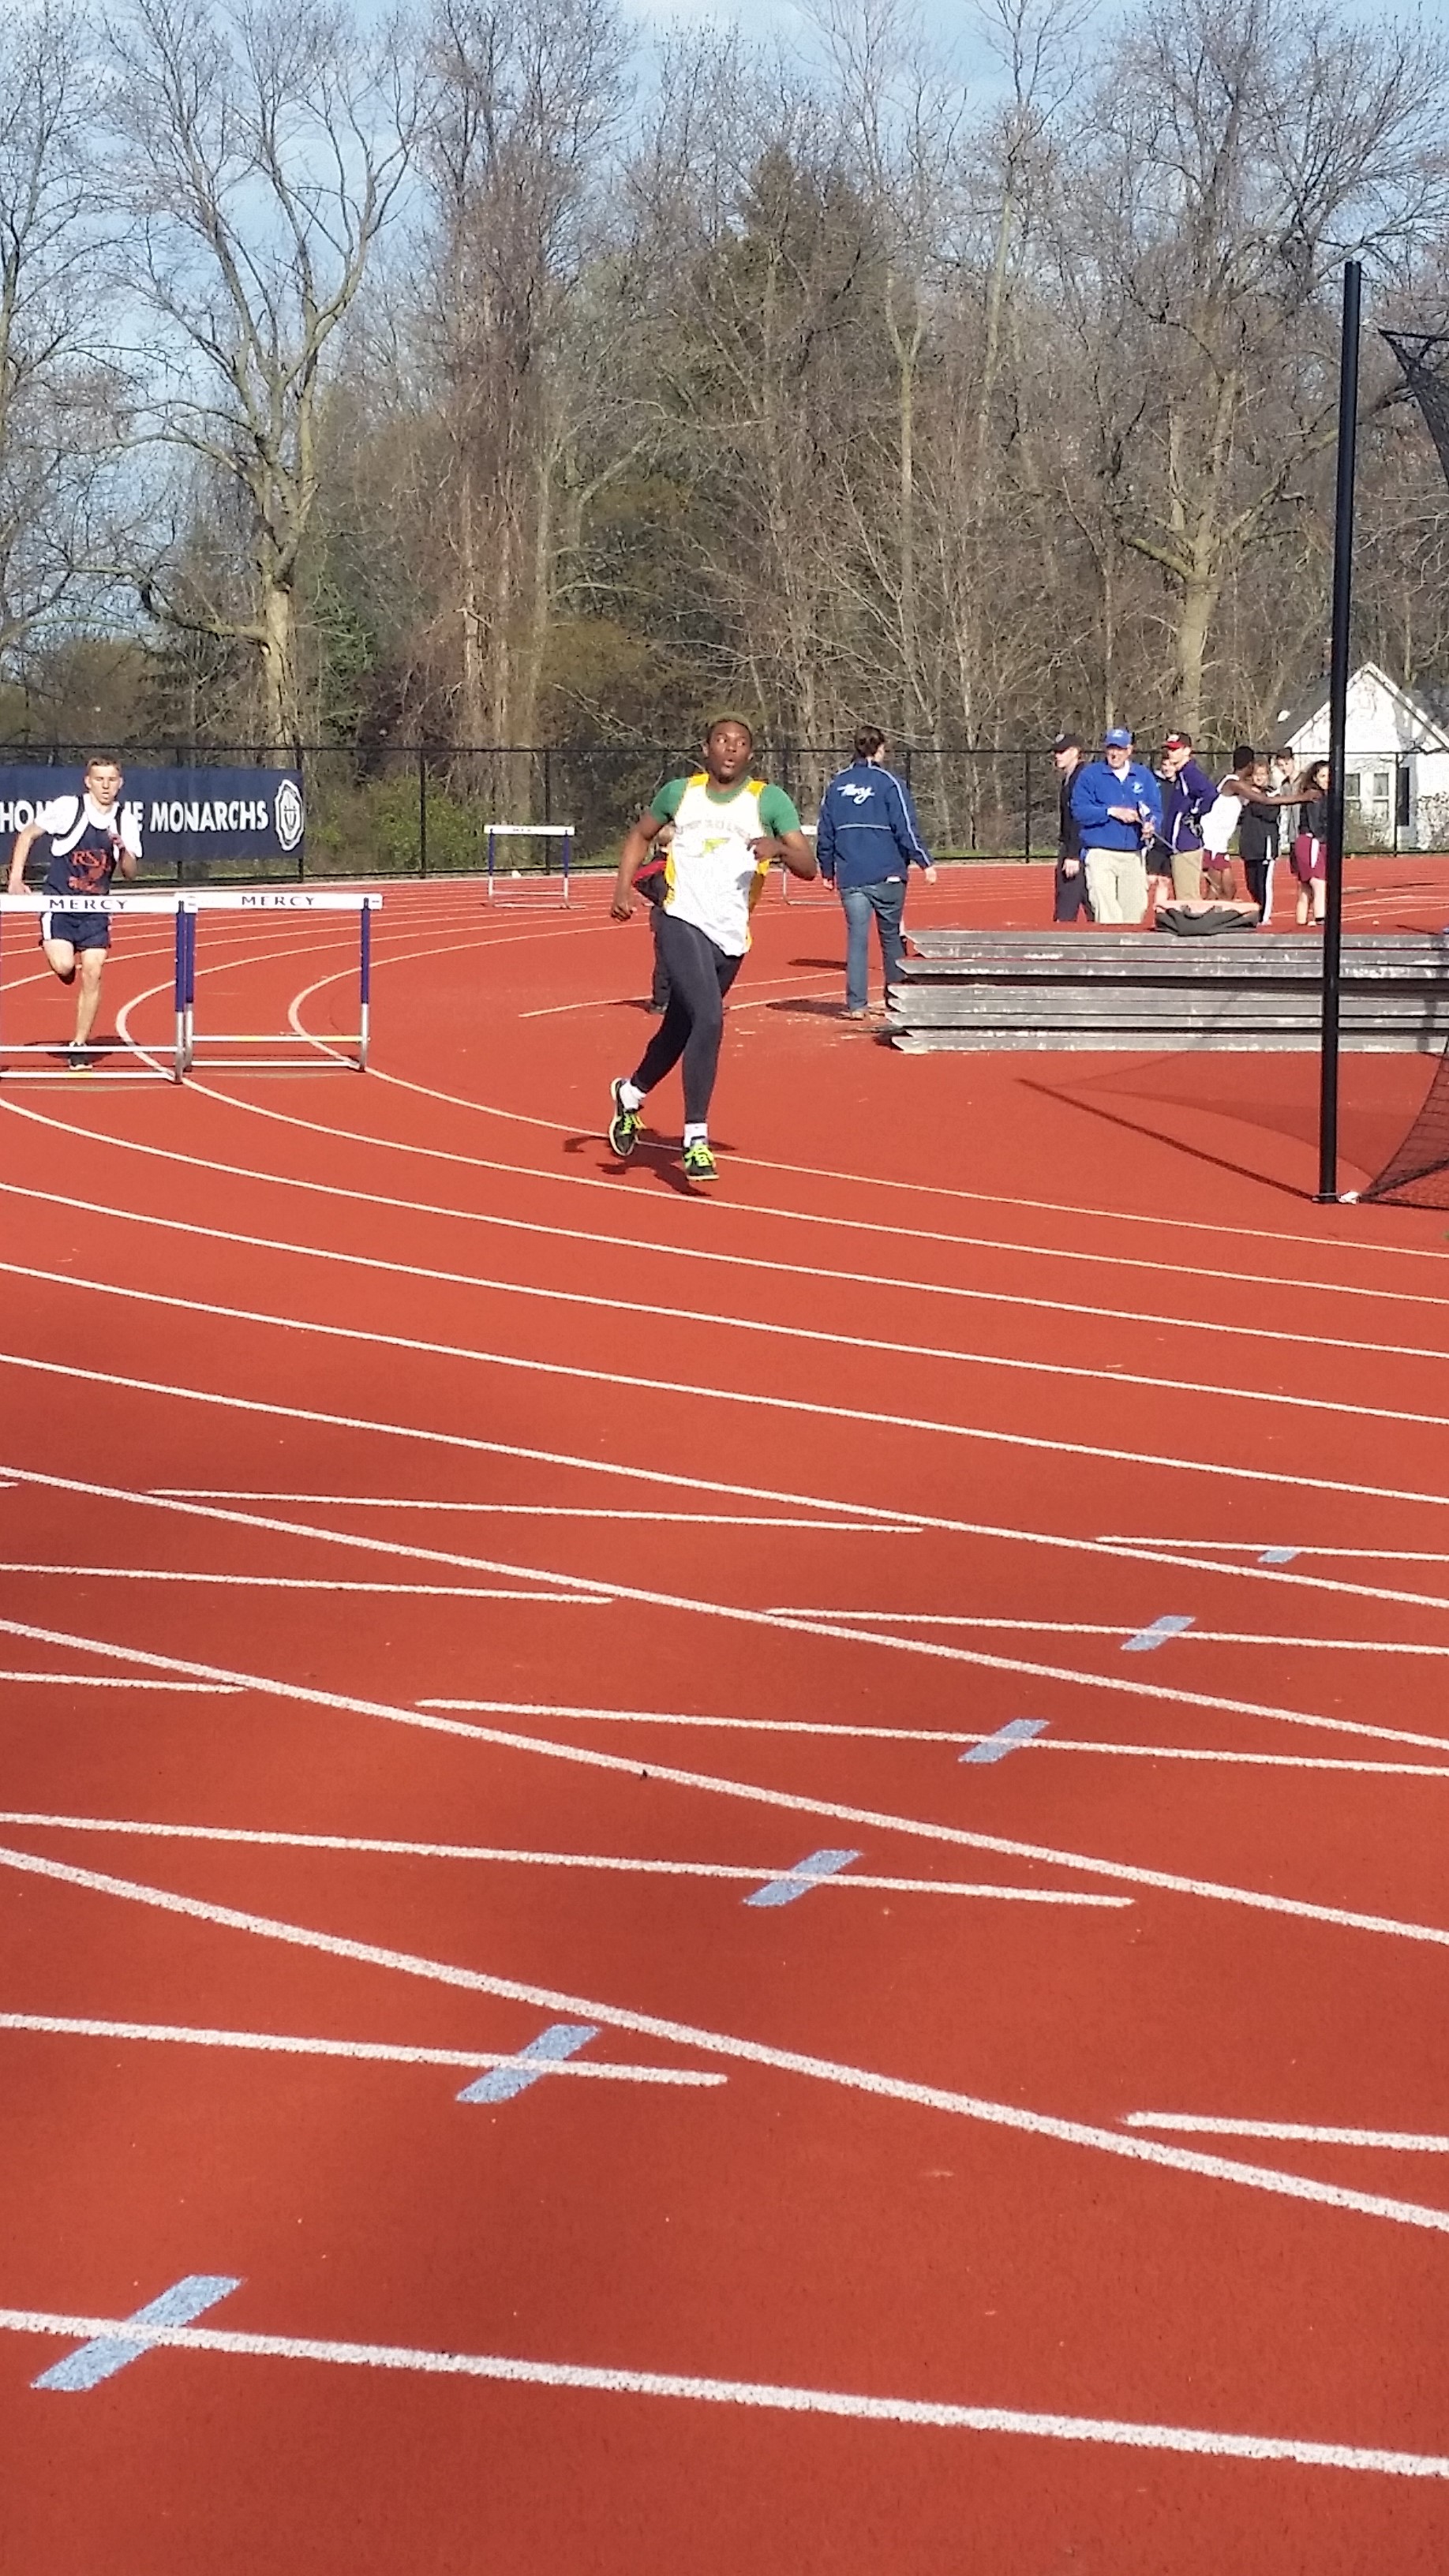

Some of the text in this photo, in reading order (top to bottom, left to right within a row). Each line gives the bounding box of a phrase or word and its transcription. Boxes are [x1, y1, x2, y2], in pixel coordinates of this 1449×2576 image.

[150, 800, 269, 832] MONARCHS
[49, 899, 128, 910] MERCY
[241, 896, 315, 906] MERCY
